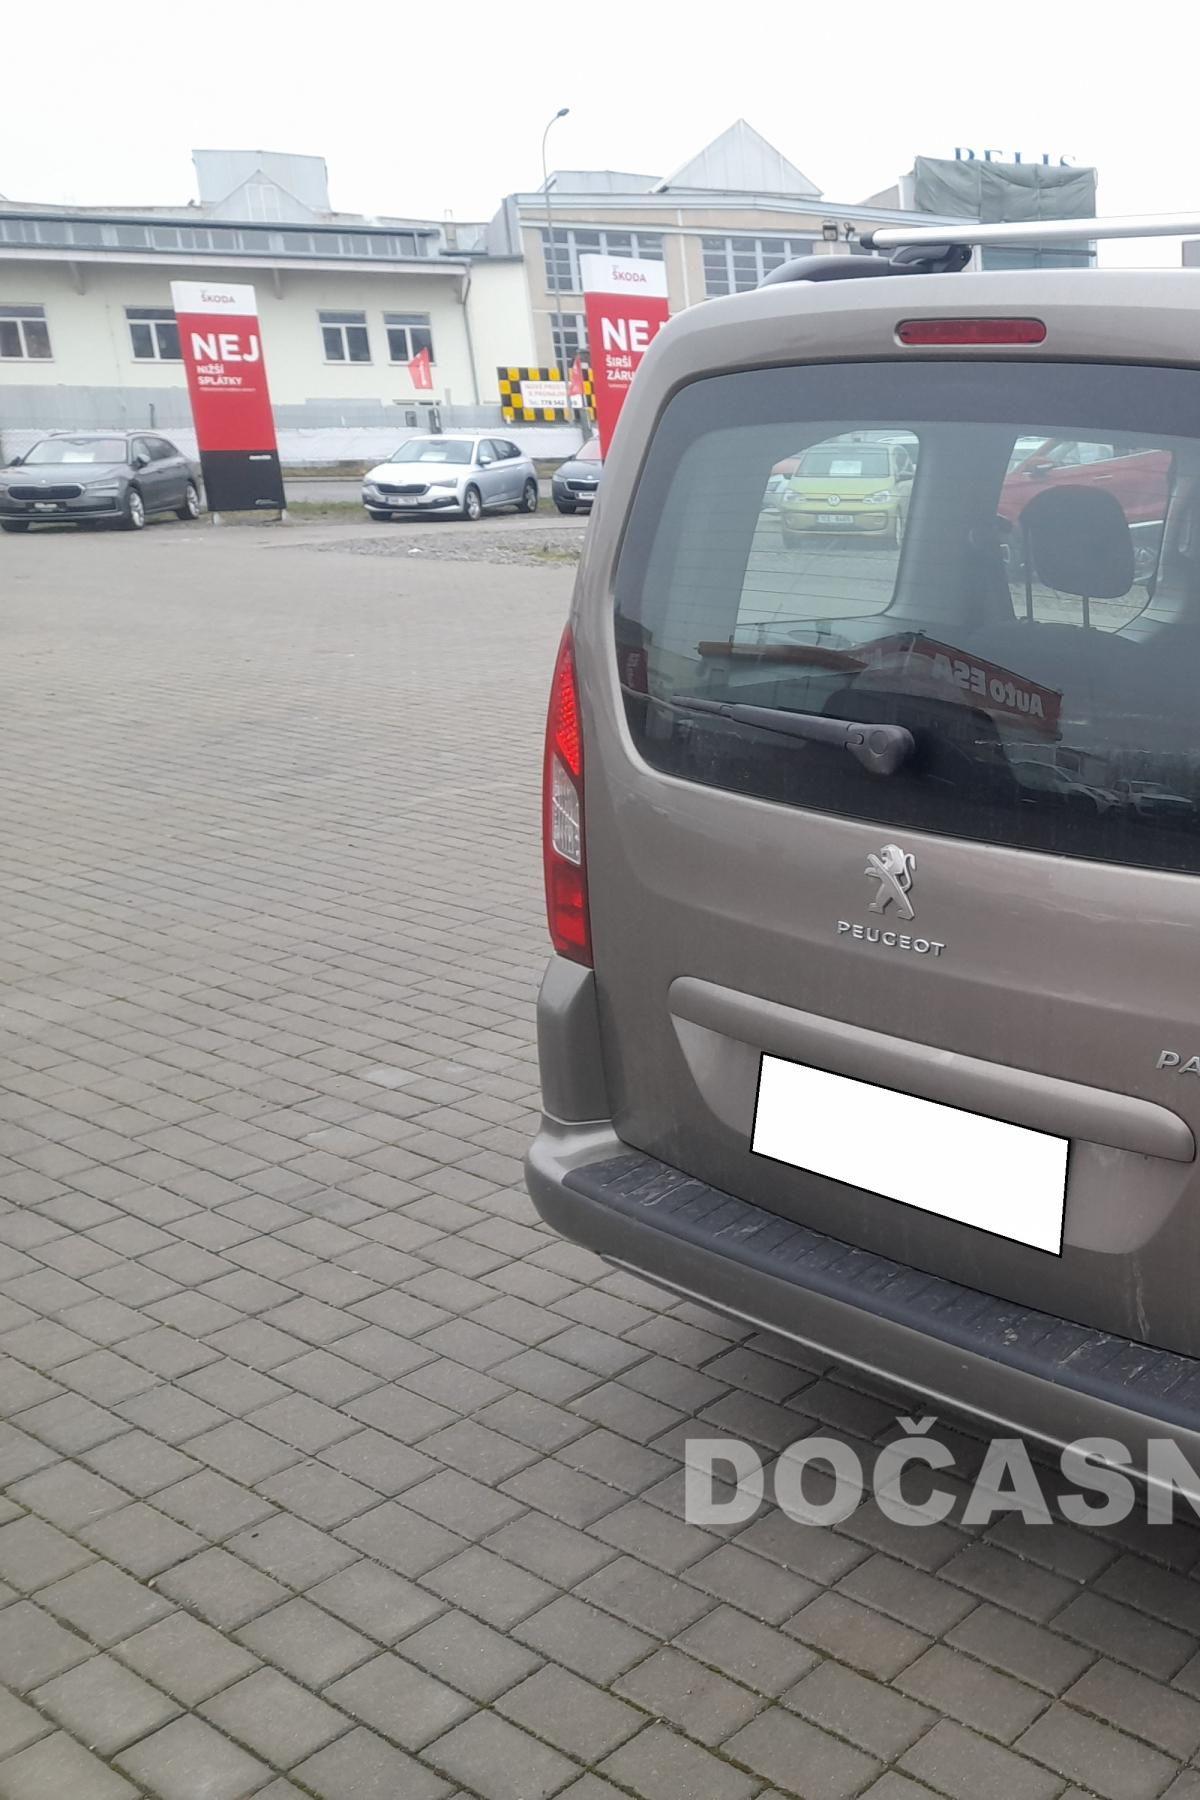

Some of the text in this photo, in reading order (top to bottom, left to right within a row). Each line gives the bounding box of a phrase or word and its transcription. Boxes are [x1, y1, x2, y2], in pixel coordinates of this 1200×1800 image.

[611, 268, 647, 282] ŠKODA
[200, 291, 236, 304] ŠKODA
[600, 317, 664, 352] NE
[190, 332, 260, 362] NEJ
[605, 353, 632, 367] ŠIRŠÍ
[198, 374, 242, 386] SPLÁTKY
[838, 920, 946, 956] PEUGEOT
